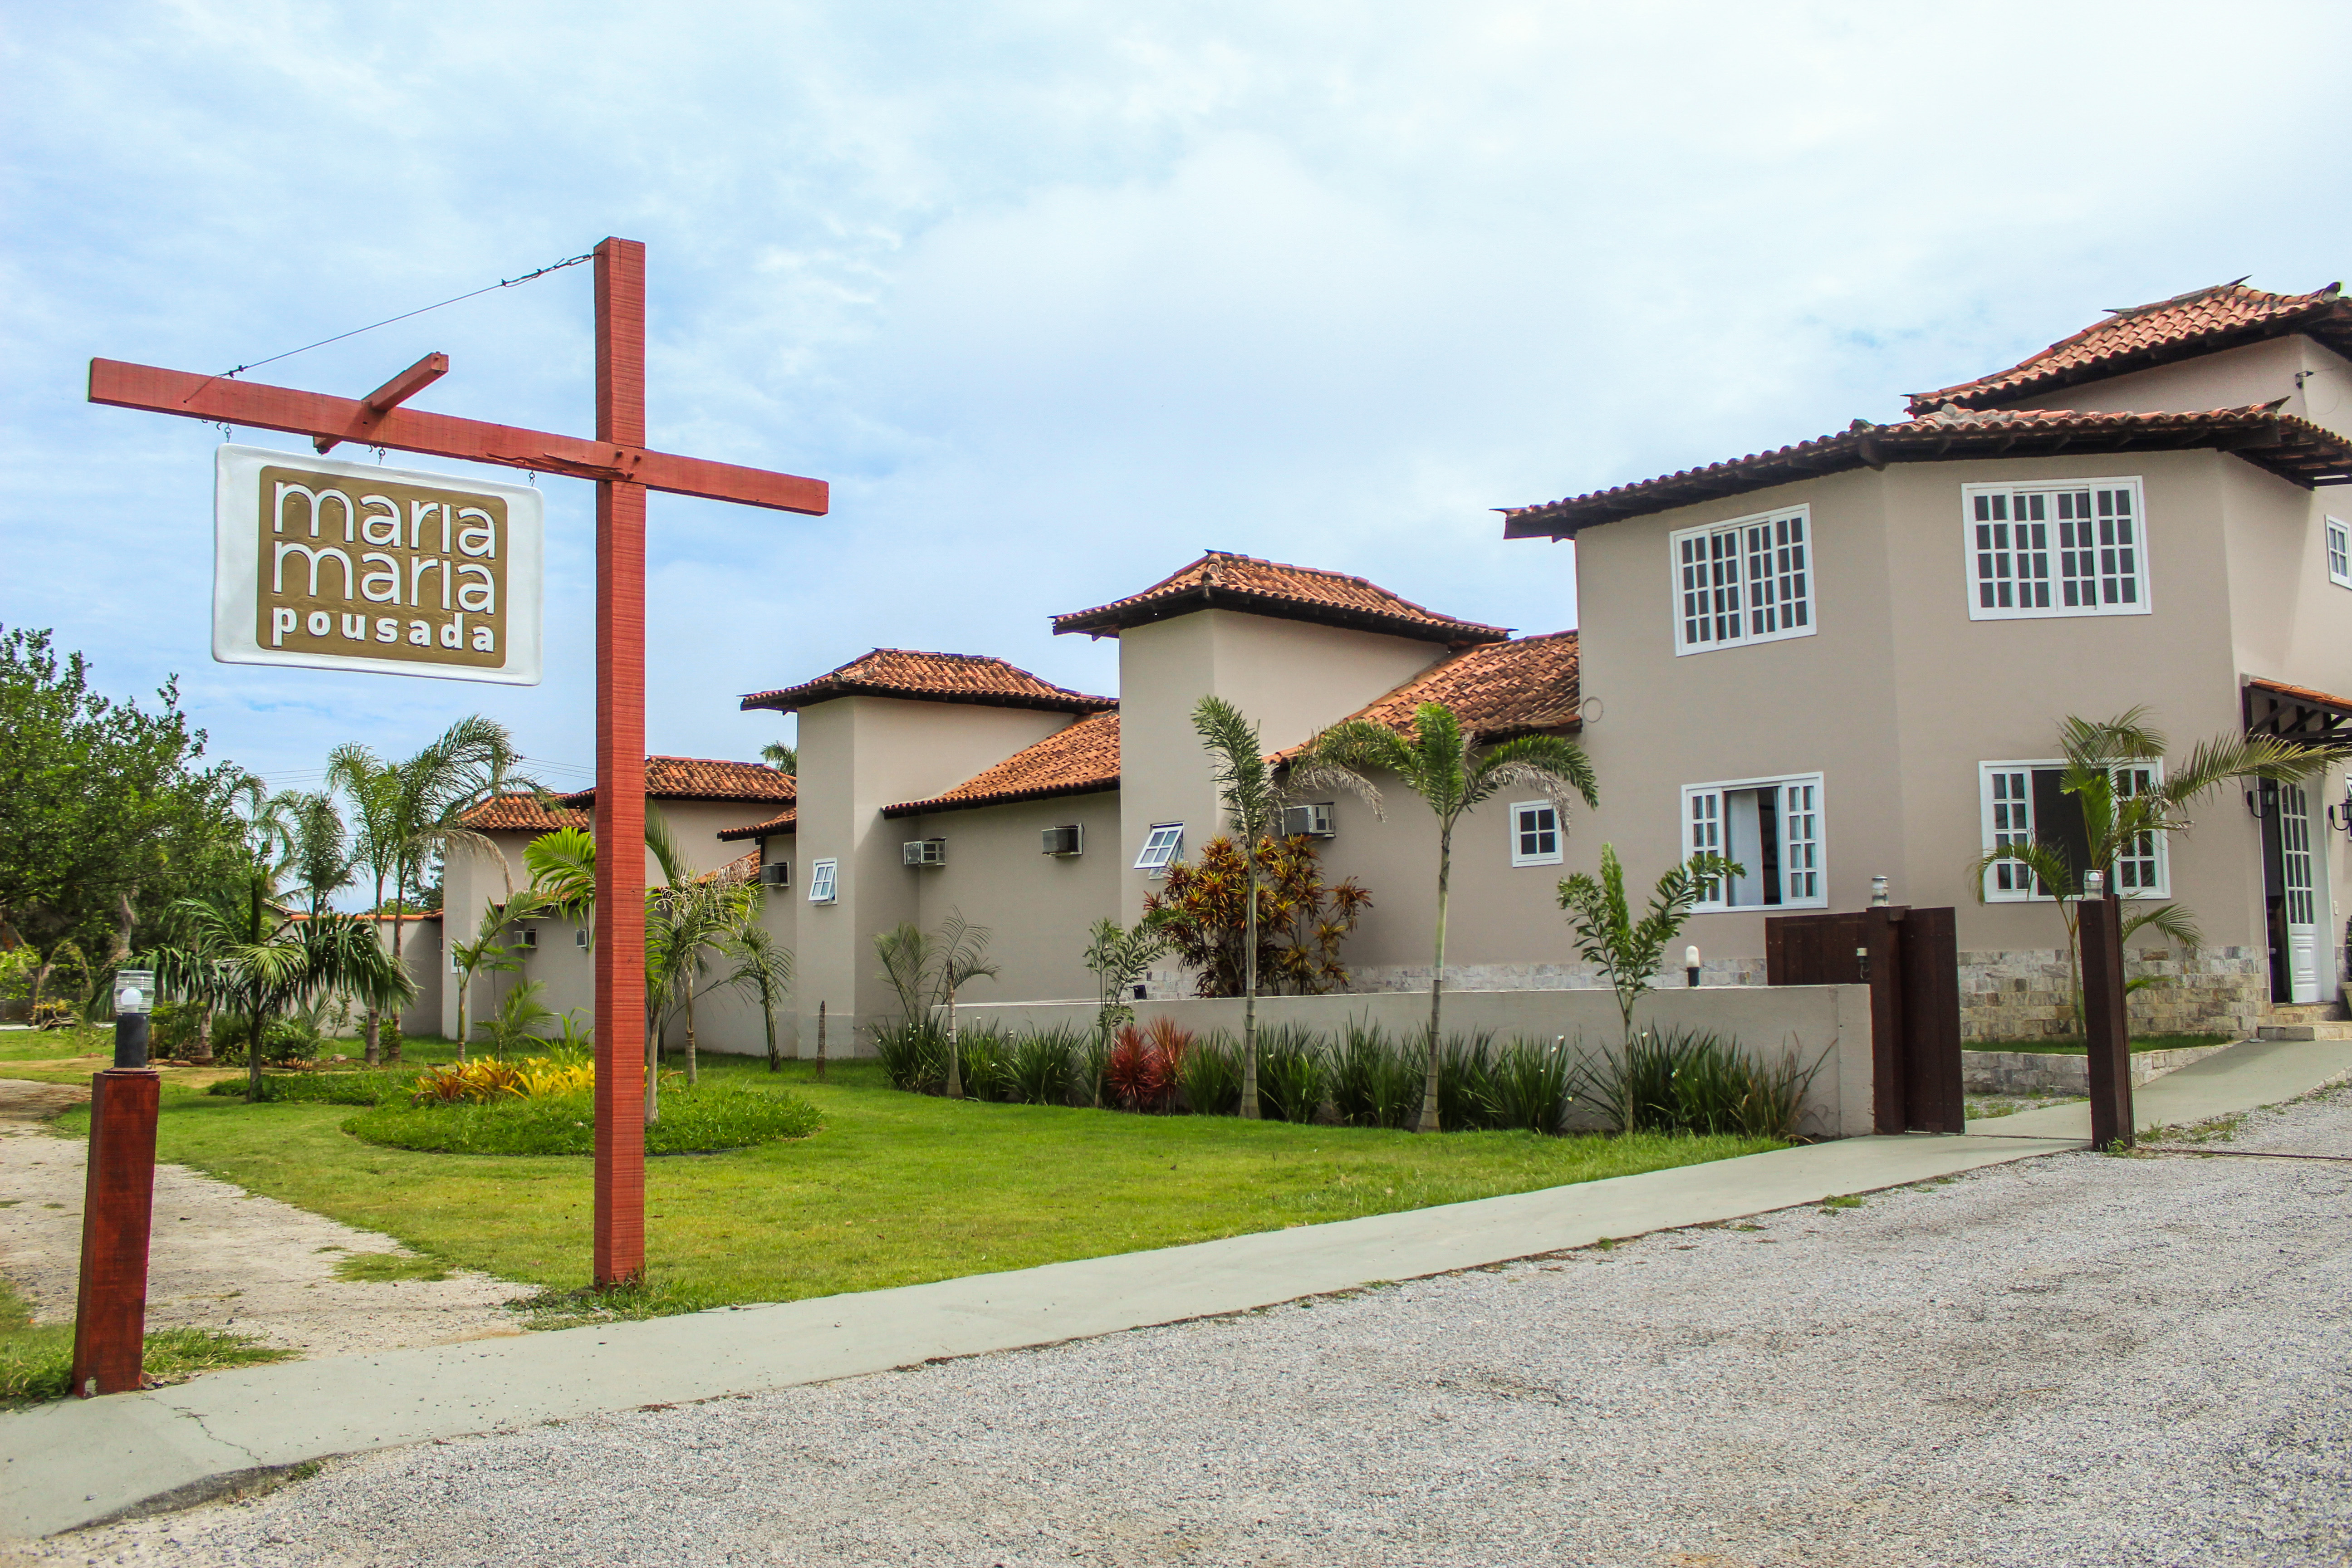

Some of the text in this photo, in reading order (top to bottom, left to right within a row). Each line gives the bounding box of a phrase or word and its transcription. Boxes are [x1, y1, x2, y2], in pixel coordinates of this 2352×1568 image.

[273, 481, 495, 559] maria
[273, 540, 495, 614] maria
[273, 607, 494, 652] pousada
